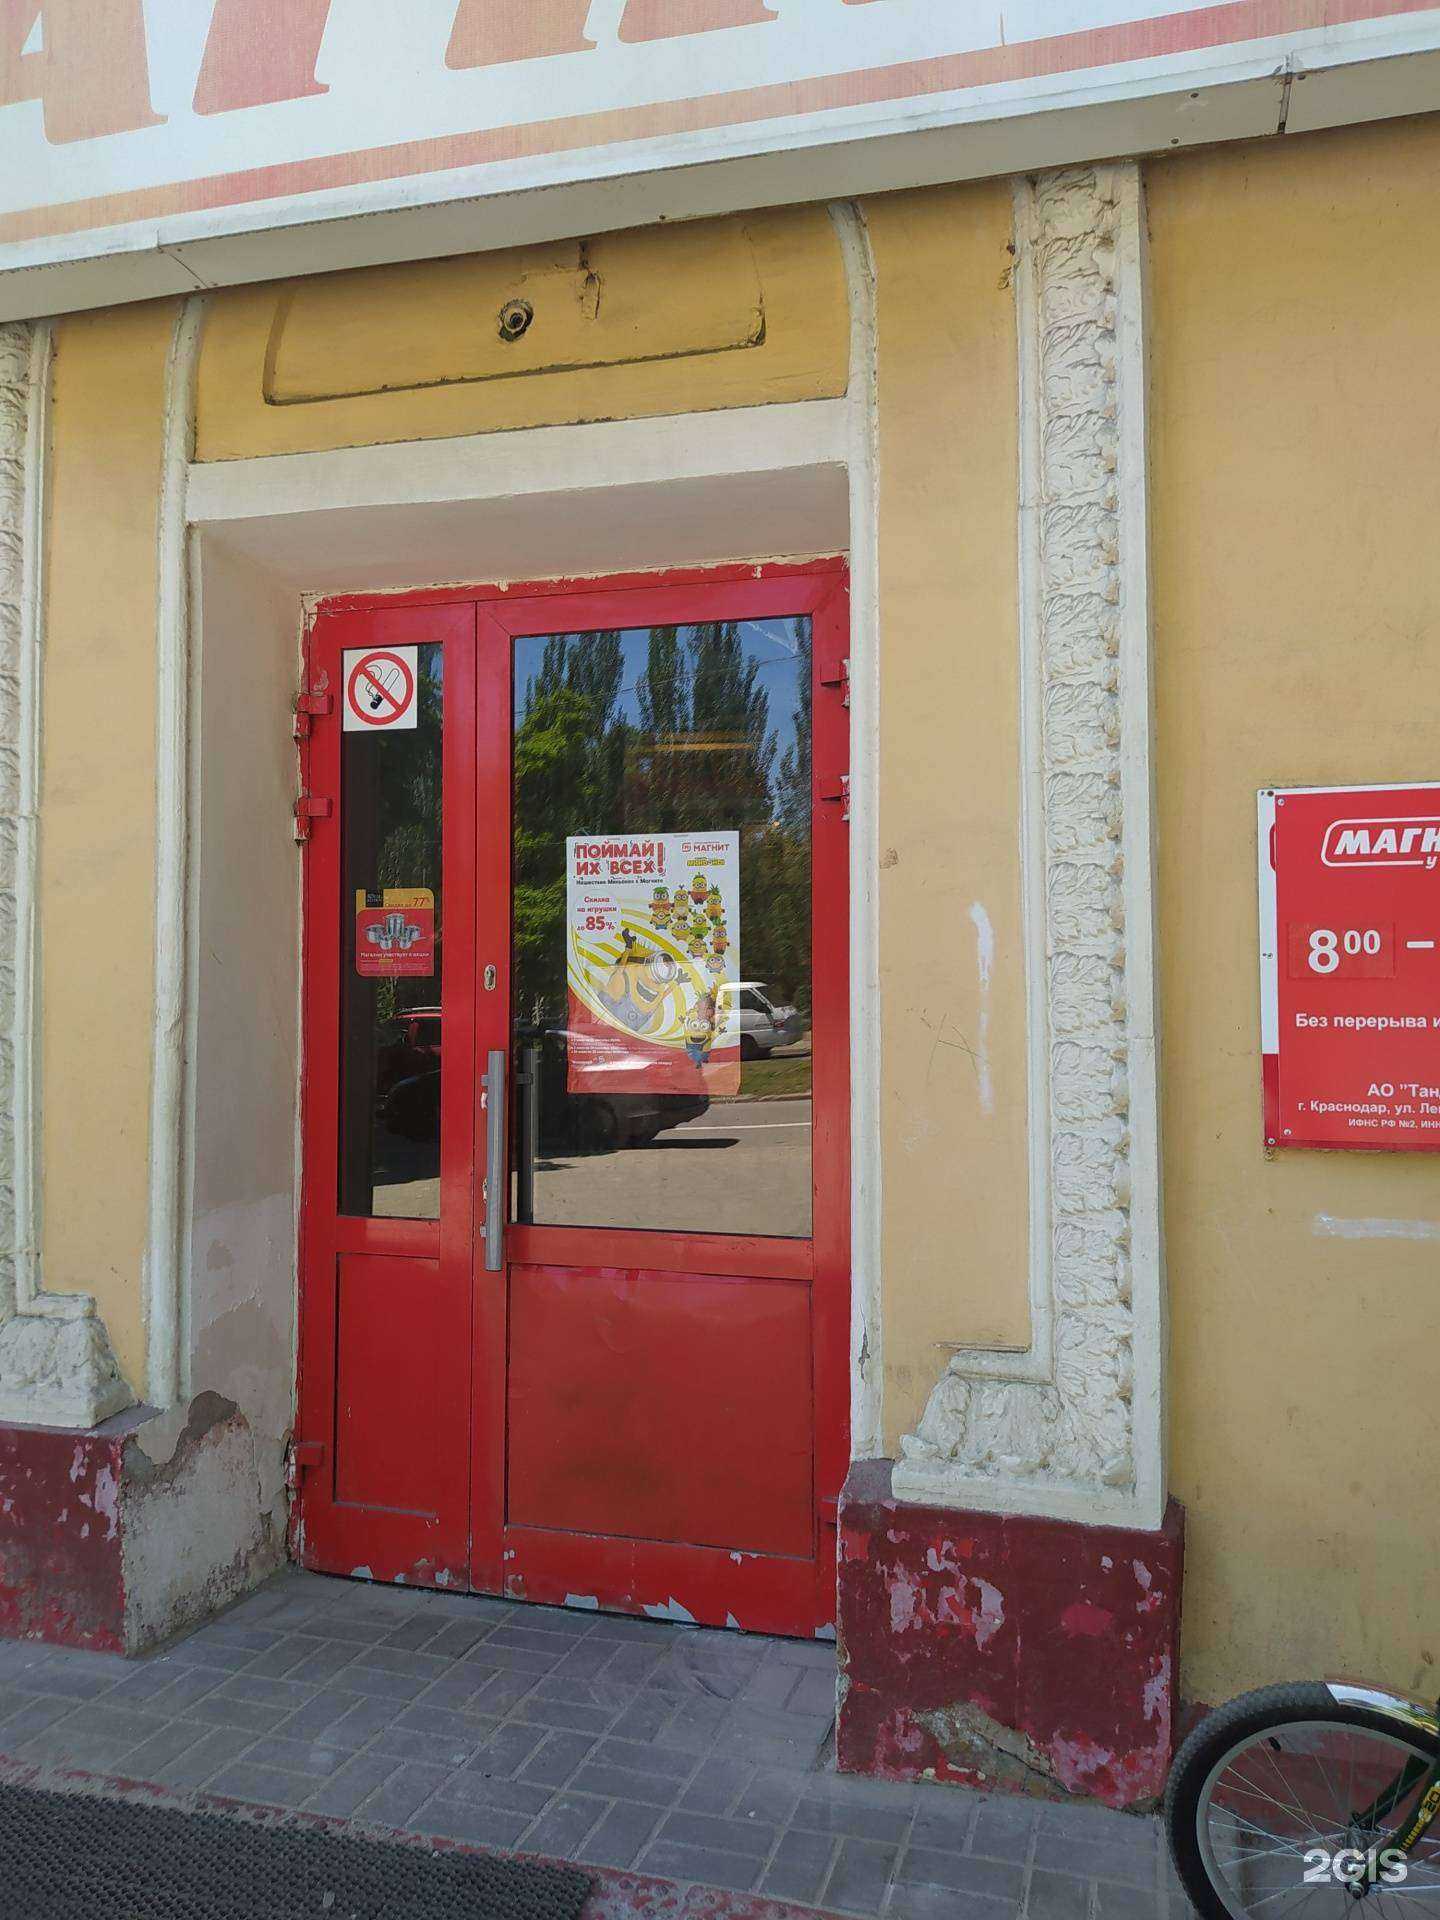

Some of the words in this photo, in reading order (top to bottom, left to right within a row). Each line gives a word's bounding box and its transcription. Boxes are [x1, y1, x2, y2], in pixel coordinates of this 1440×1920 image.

[576, 840, 655, 859] ПОЙМАЙ
[694, 843, 730, 852] МАГНИТ
[576, 863, 601, 876] ИХ
[1295, 1013, 1328, 1028] Без
[1333, 1016, 1427, 1030] перерыва
[1367, 1083, 1395, 1097] АО
[1399, 1083, 1440, 1098] "Тан
[1310, 1101, 1391, 1115] Краснодар,
[1395, 1104, 1416, 1115] ул.
[1348, 1118, 1379, 1127] ИФНС
[1381, 1119, 1396, 1128] РФ
